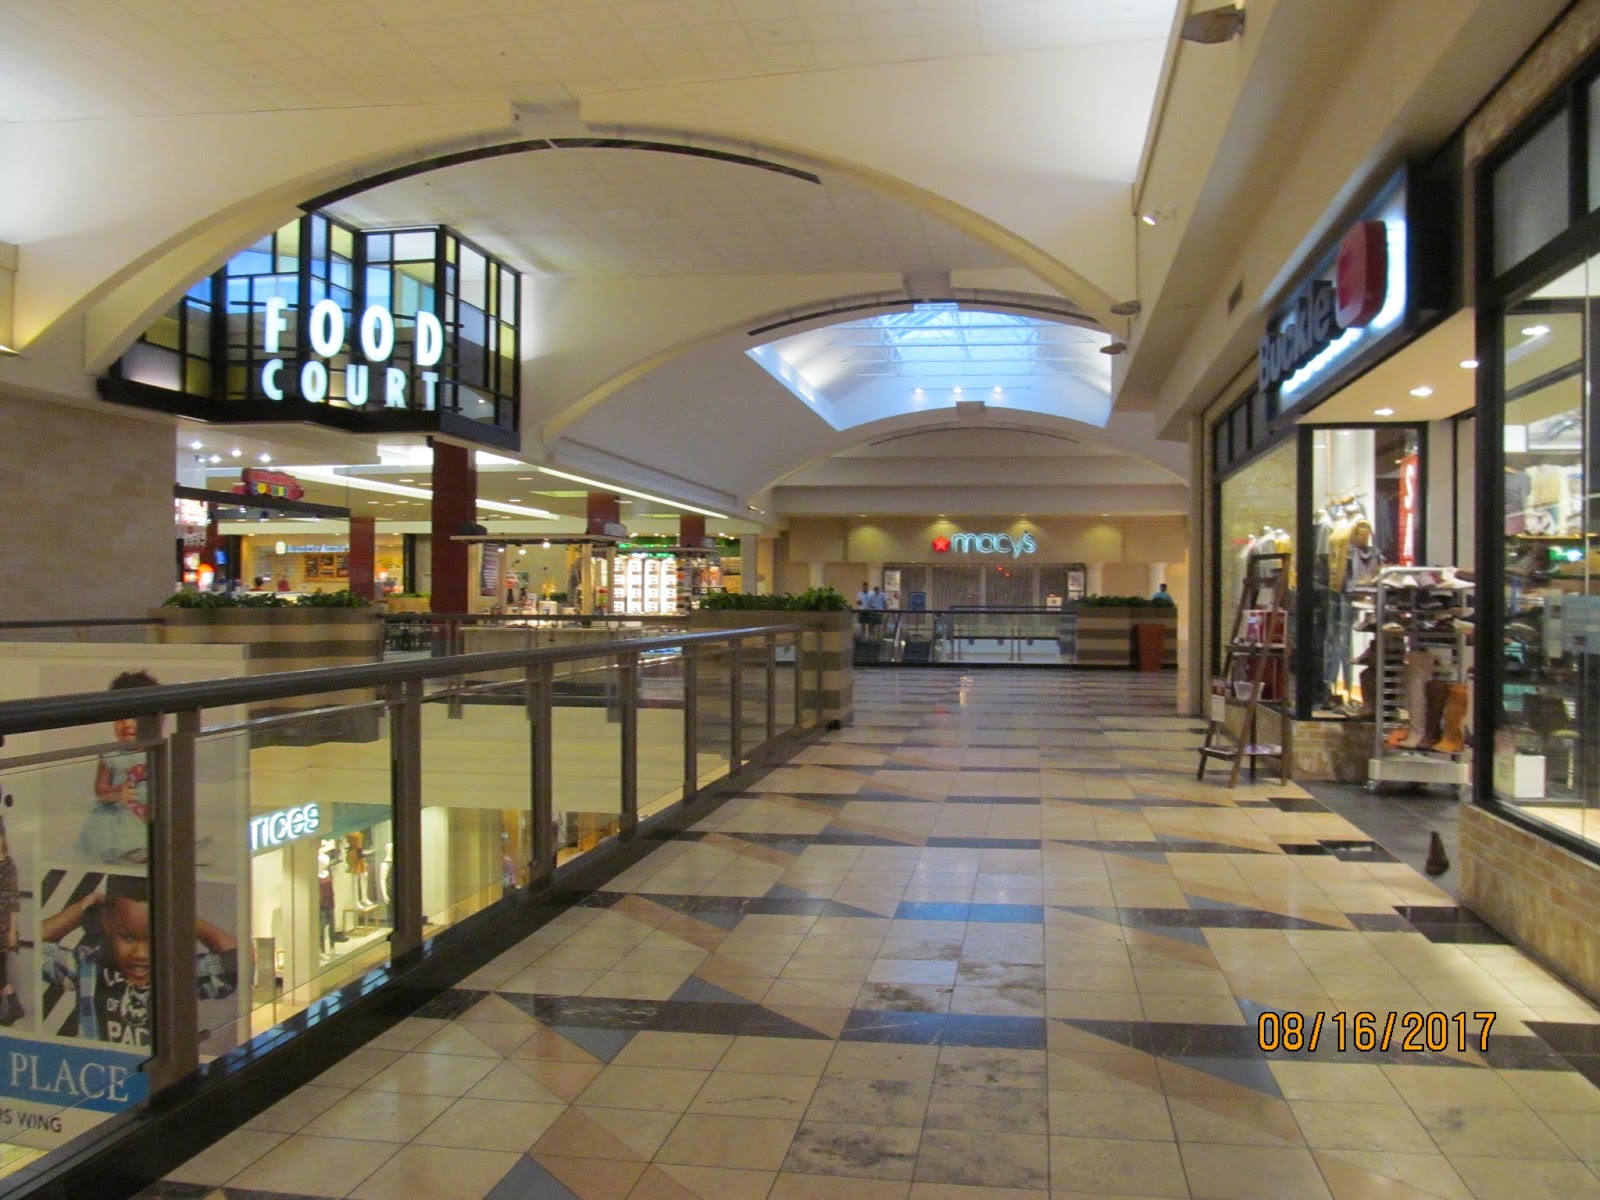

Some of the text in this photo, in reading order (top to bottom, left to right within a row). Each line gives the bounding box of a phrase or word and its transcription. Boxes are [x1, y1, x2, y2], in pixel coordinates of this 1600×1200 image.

[264, 296, 444, 367] FOOD
[261, 358, 440, 412] COURT
[950, 532, 1037, 560] macy's
[8, 1051, 129, 1103] PLACE
[17, 1111, 63, 1134] WING
